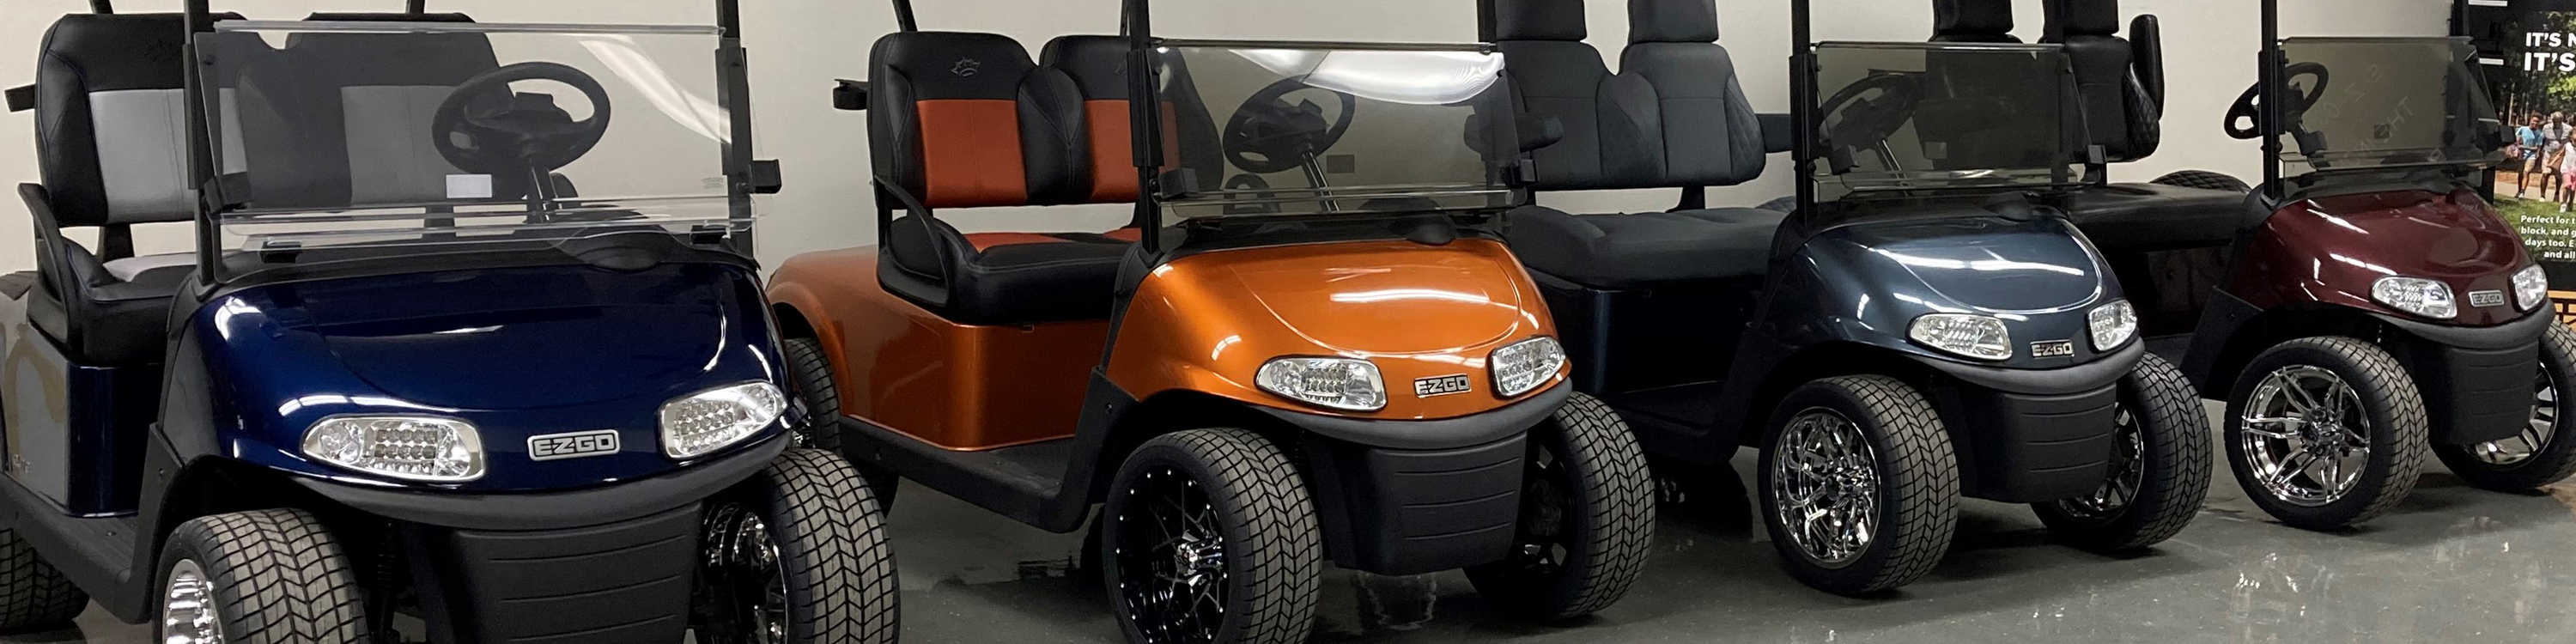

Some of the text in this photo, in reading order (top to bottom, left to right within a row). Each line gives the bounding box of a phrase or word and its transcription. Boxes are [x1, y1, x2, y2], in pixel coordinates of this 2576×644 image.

[2525, 32, 2561, 47] IT'S
[2524, 52, 2576, 72] IT'S
[2520, 215, 2554, 224] Perfect
[2555, 216, 2570, 224] for
[2520, 226, 2549, 235] block,
[2550, 228, 2569, 236] and
[2524, 238, 2547, 248] days
[2543, 250, 2576, 259] and all
